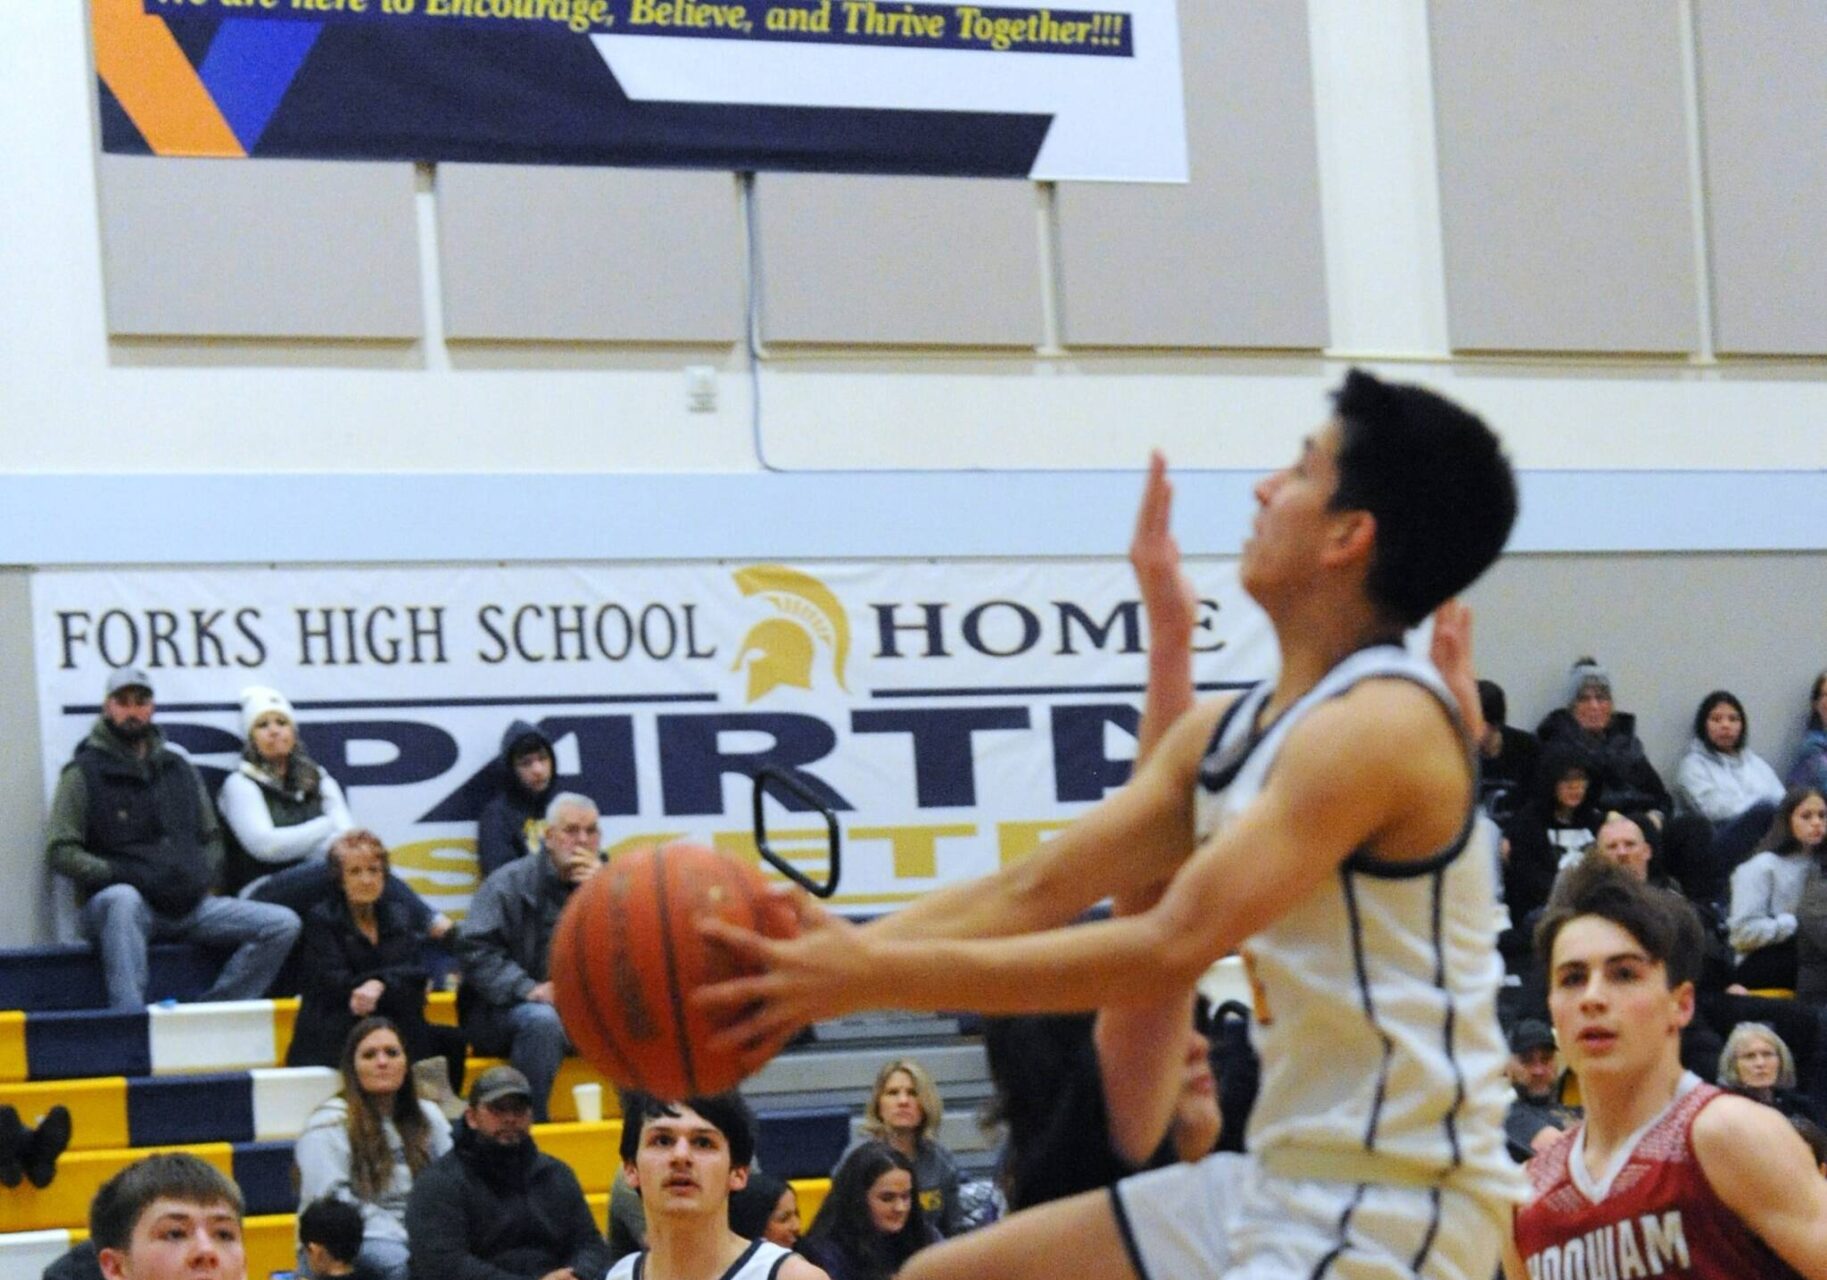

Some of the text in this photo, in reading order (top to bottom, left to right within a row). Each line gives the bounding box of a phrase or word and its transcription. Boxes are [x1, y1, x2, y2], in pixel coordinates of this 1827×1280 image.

[630, 0, 753, 33] Believe,
[765, 1, 831, 33] and
[843, 1, 945, 38] Thrive
[957, 5, 1123, 50] Together!!!
[58, 603, 717, 669] FORKS HIGH SCHOOL
